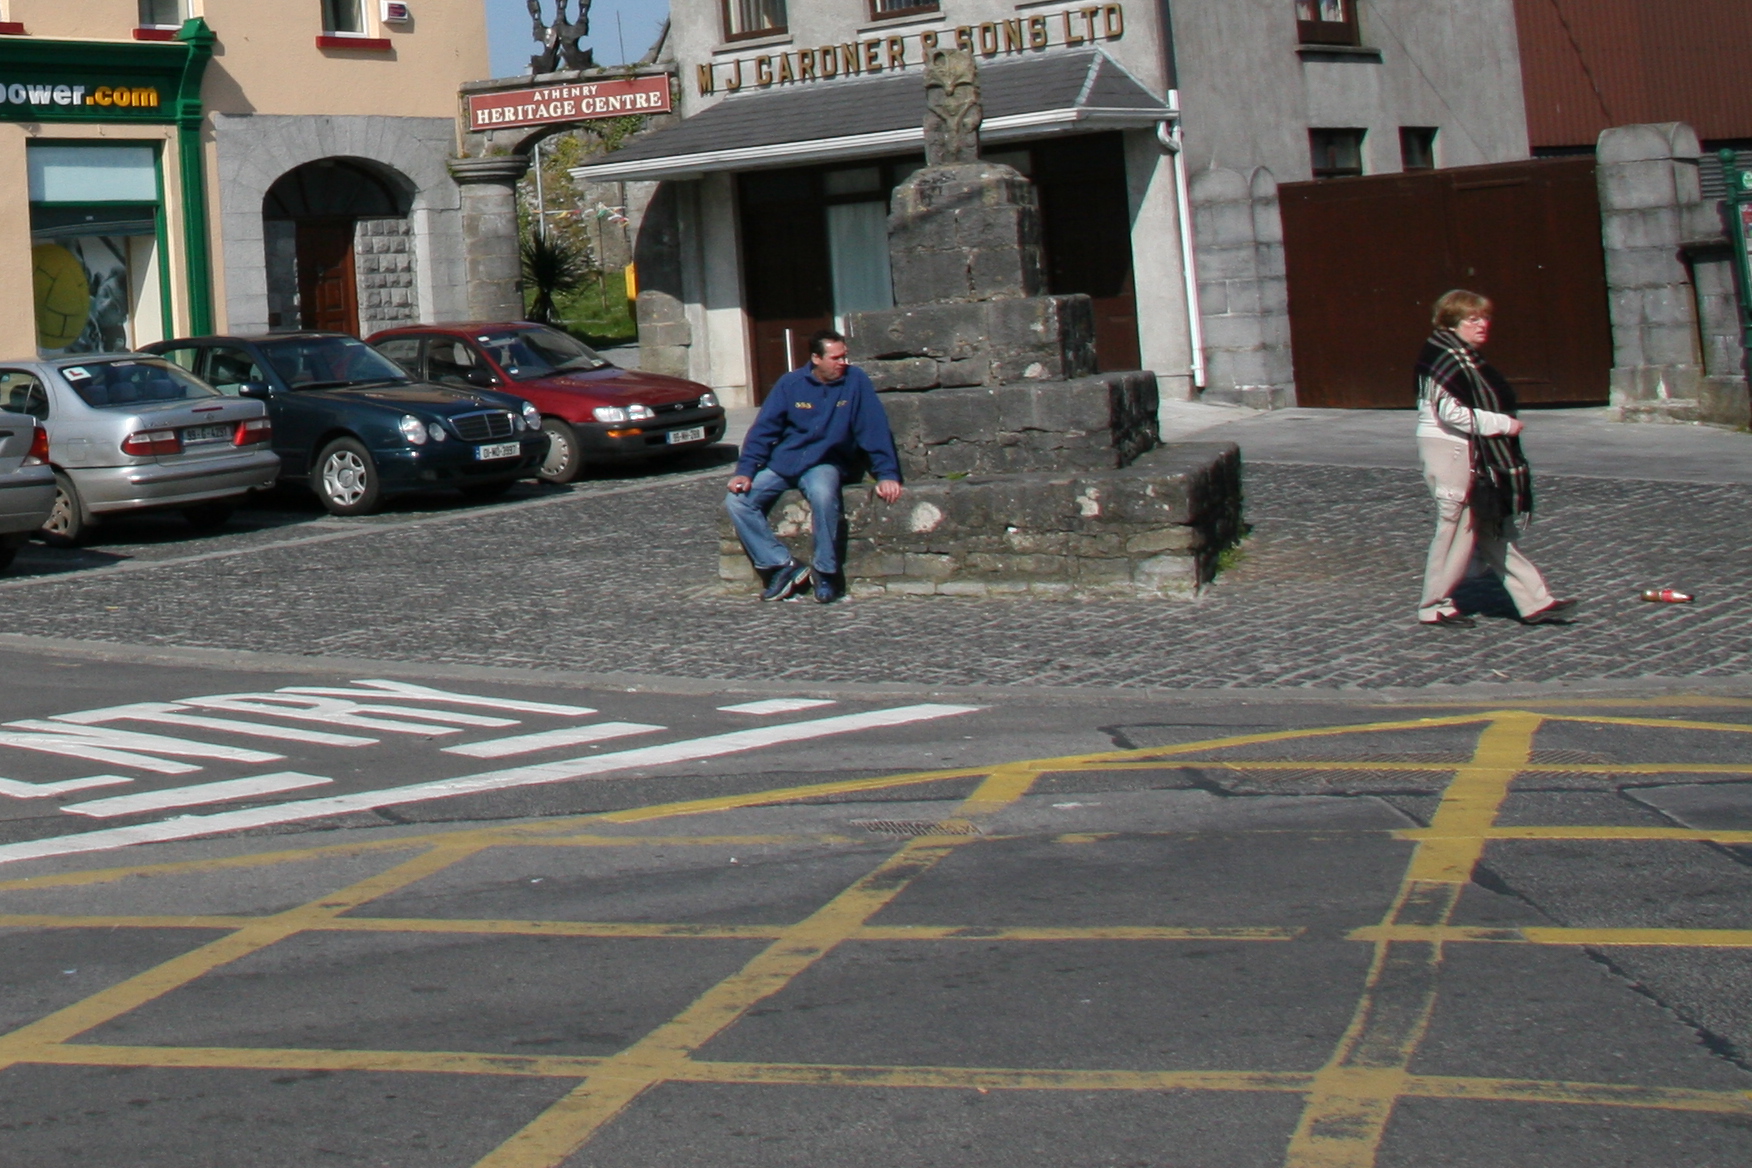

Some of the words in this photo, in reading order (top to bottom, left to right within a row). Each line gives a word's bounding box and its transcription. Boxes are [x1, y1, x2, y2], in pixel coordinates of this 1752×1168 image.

[696, 63, 714, 97] M
[725, 58, 741, 90] J
[754, 35, 905, 86] GARDNER
[954, 14, 1048, 54] SONS
[1062, 3, 1124, 47] LTD
[533, 84, 598, 102] ATHENRY
[476, 100, 576, 125] HERITAGE
[581, 91, 662, 113] CENTRE
[68, 369, 84, 378] L
